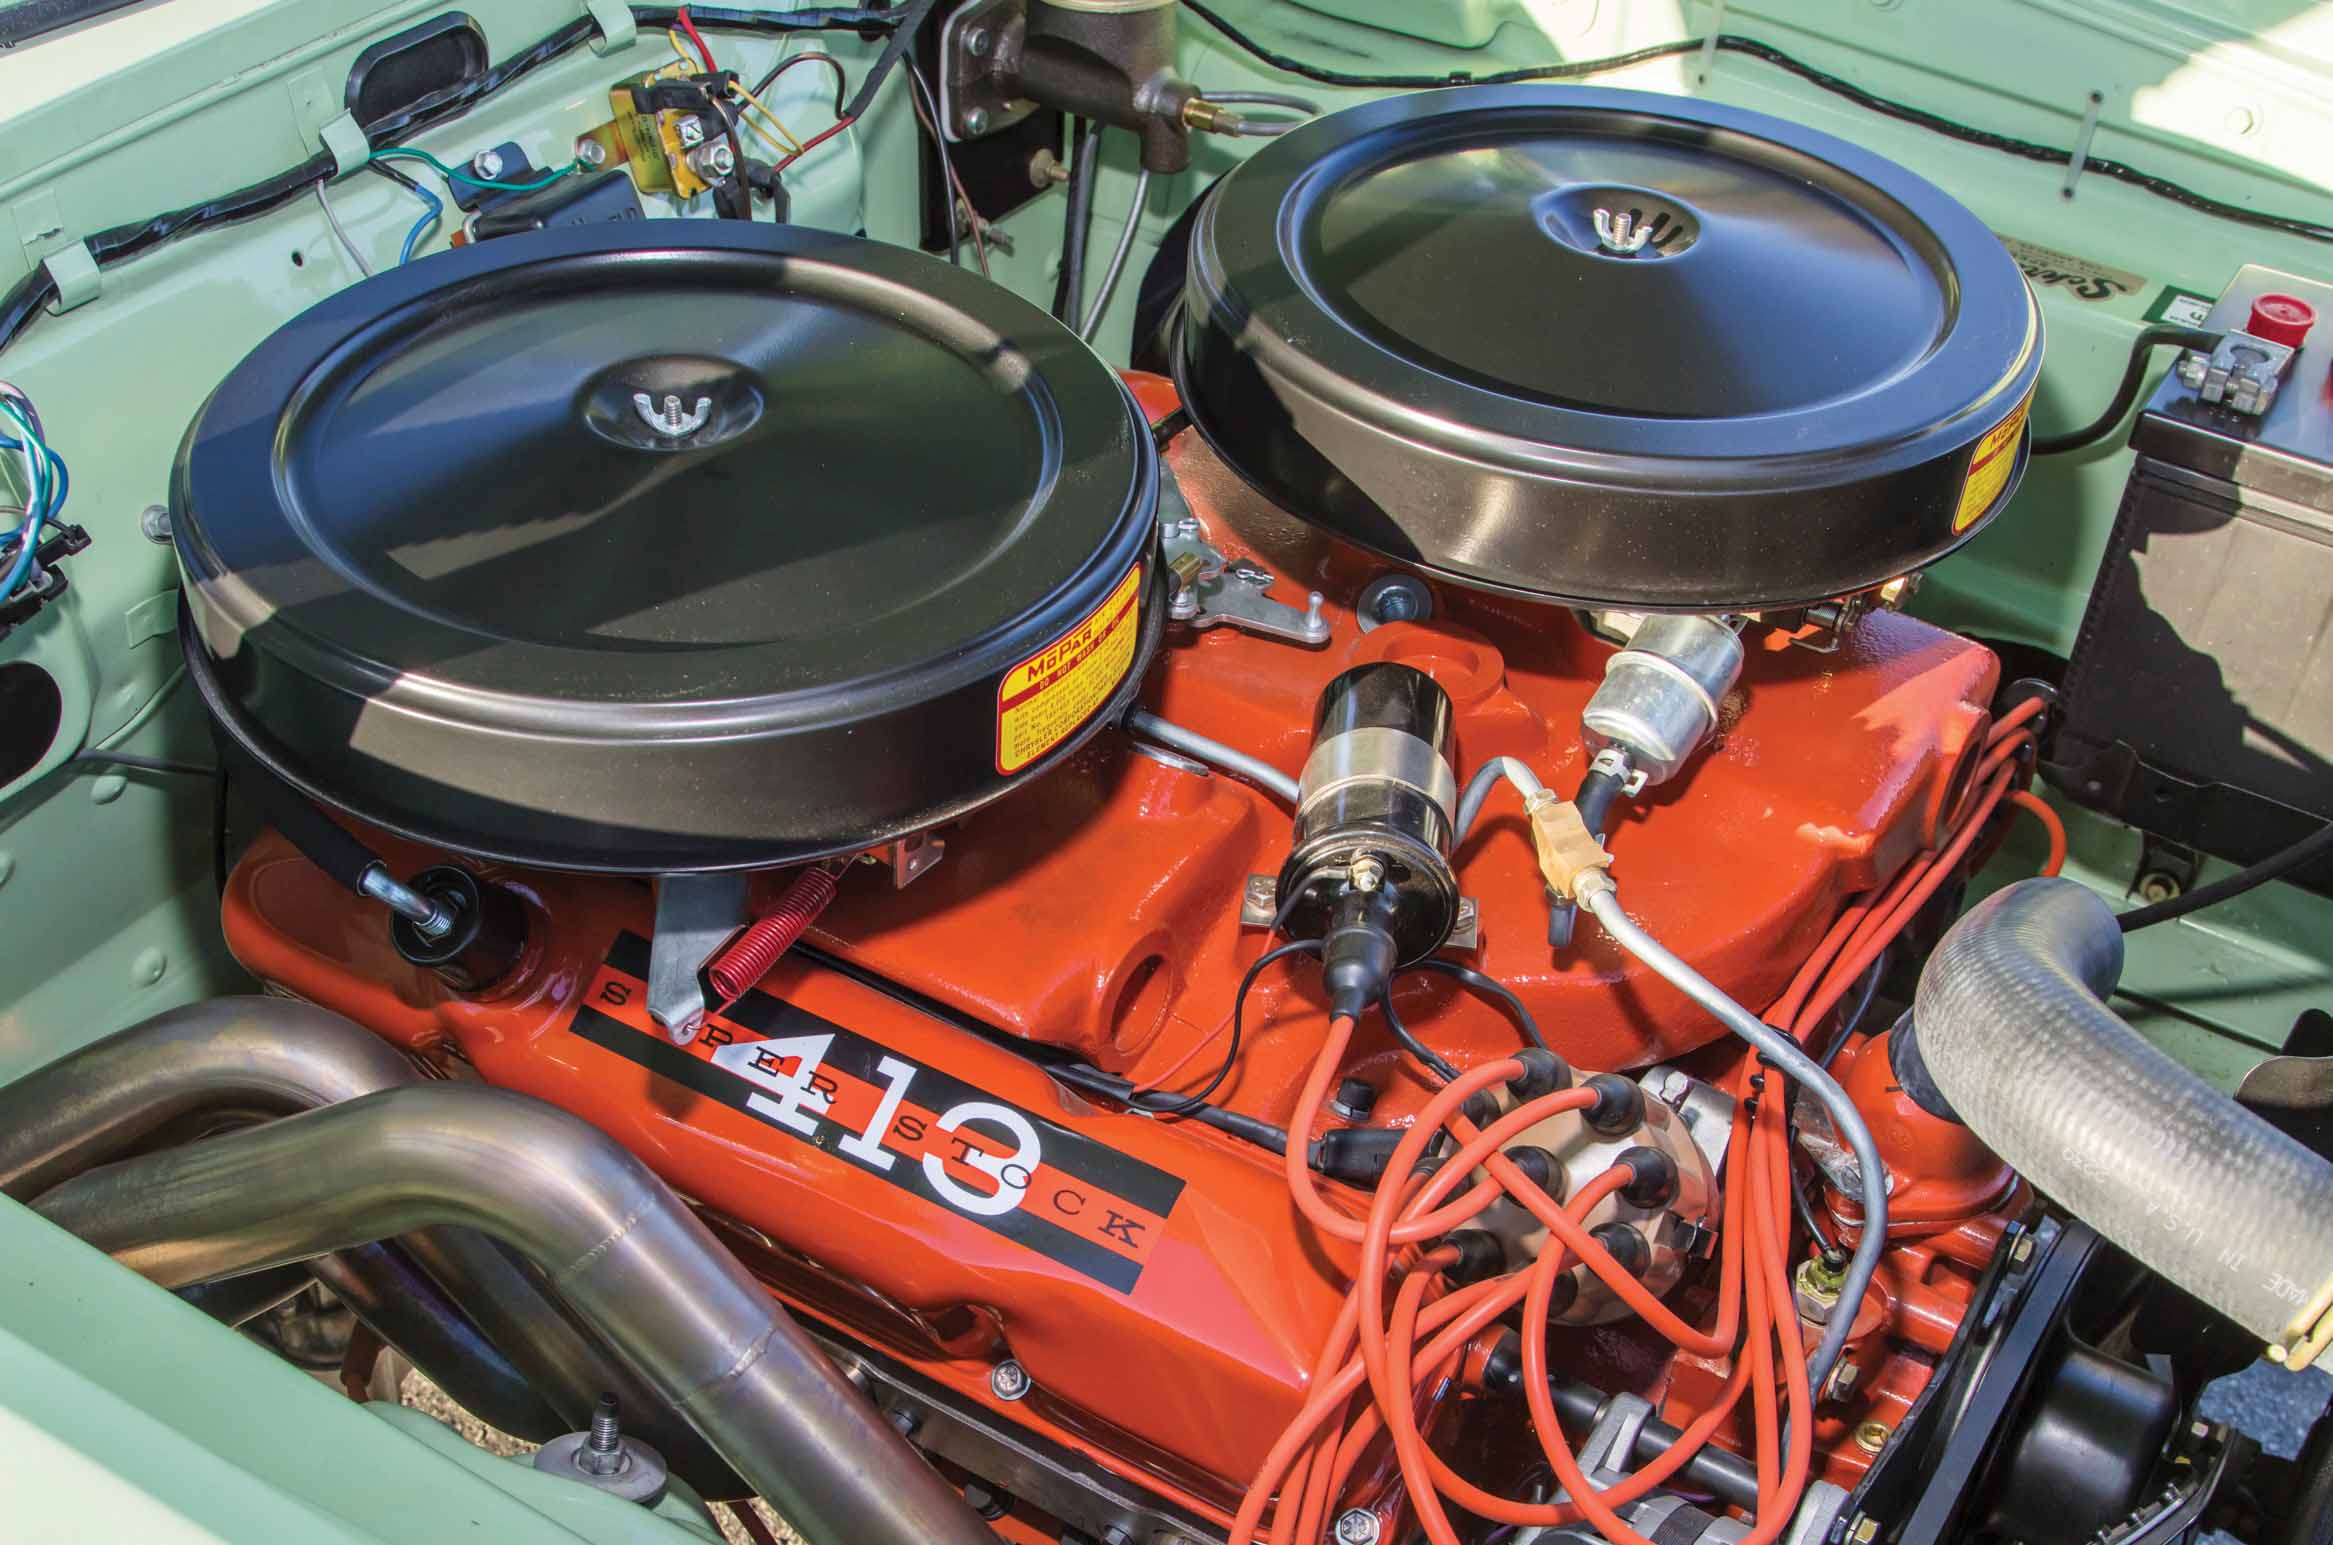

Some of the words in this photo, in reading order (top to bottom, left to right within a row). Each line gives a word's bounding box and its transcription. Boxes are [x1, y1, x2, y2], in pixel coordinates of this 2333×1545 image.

[1040, 677, 1050, 690] DO
[1058, 661, 1071, 677] NOT
[1076, 641, 1094, 663] WASH
[599, 980, 839, 1105] SPER
[892, 1115, 1146, 1249] STOCK
[710, 1033, 1041, 1216] 413
